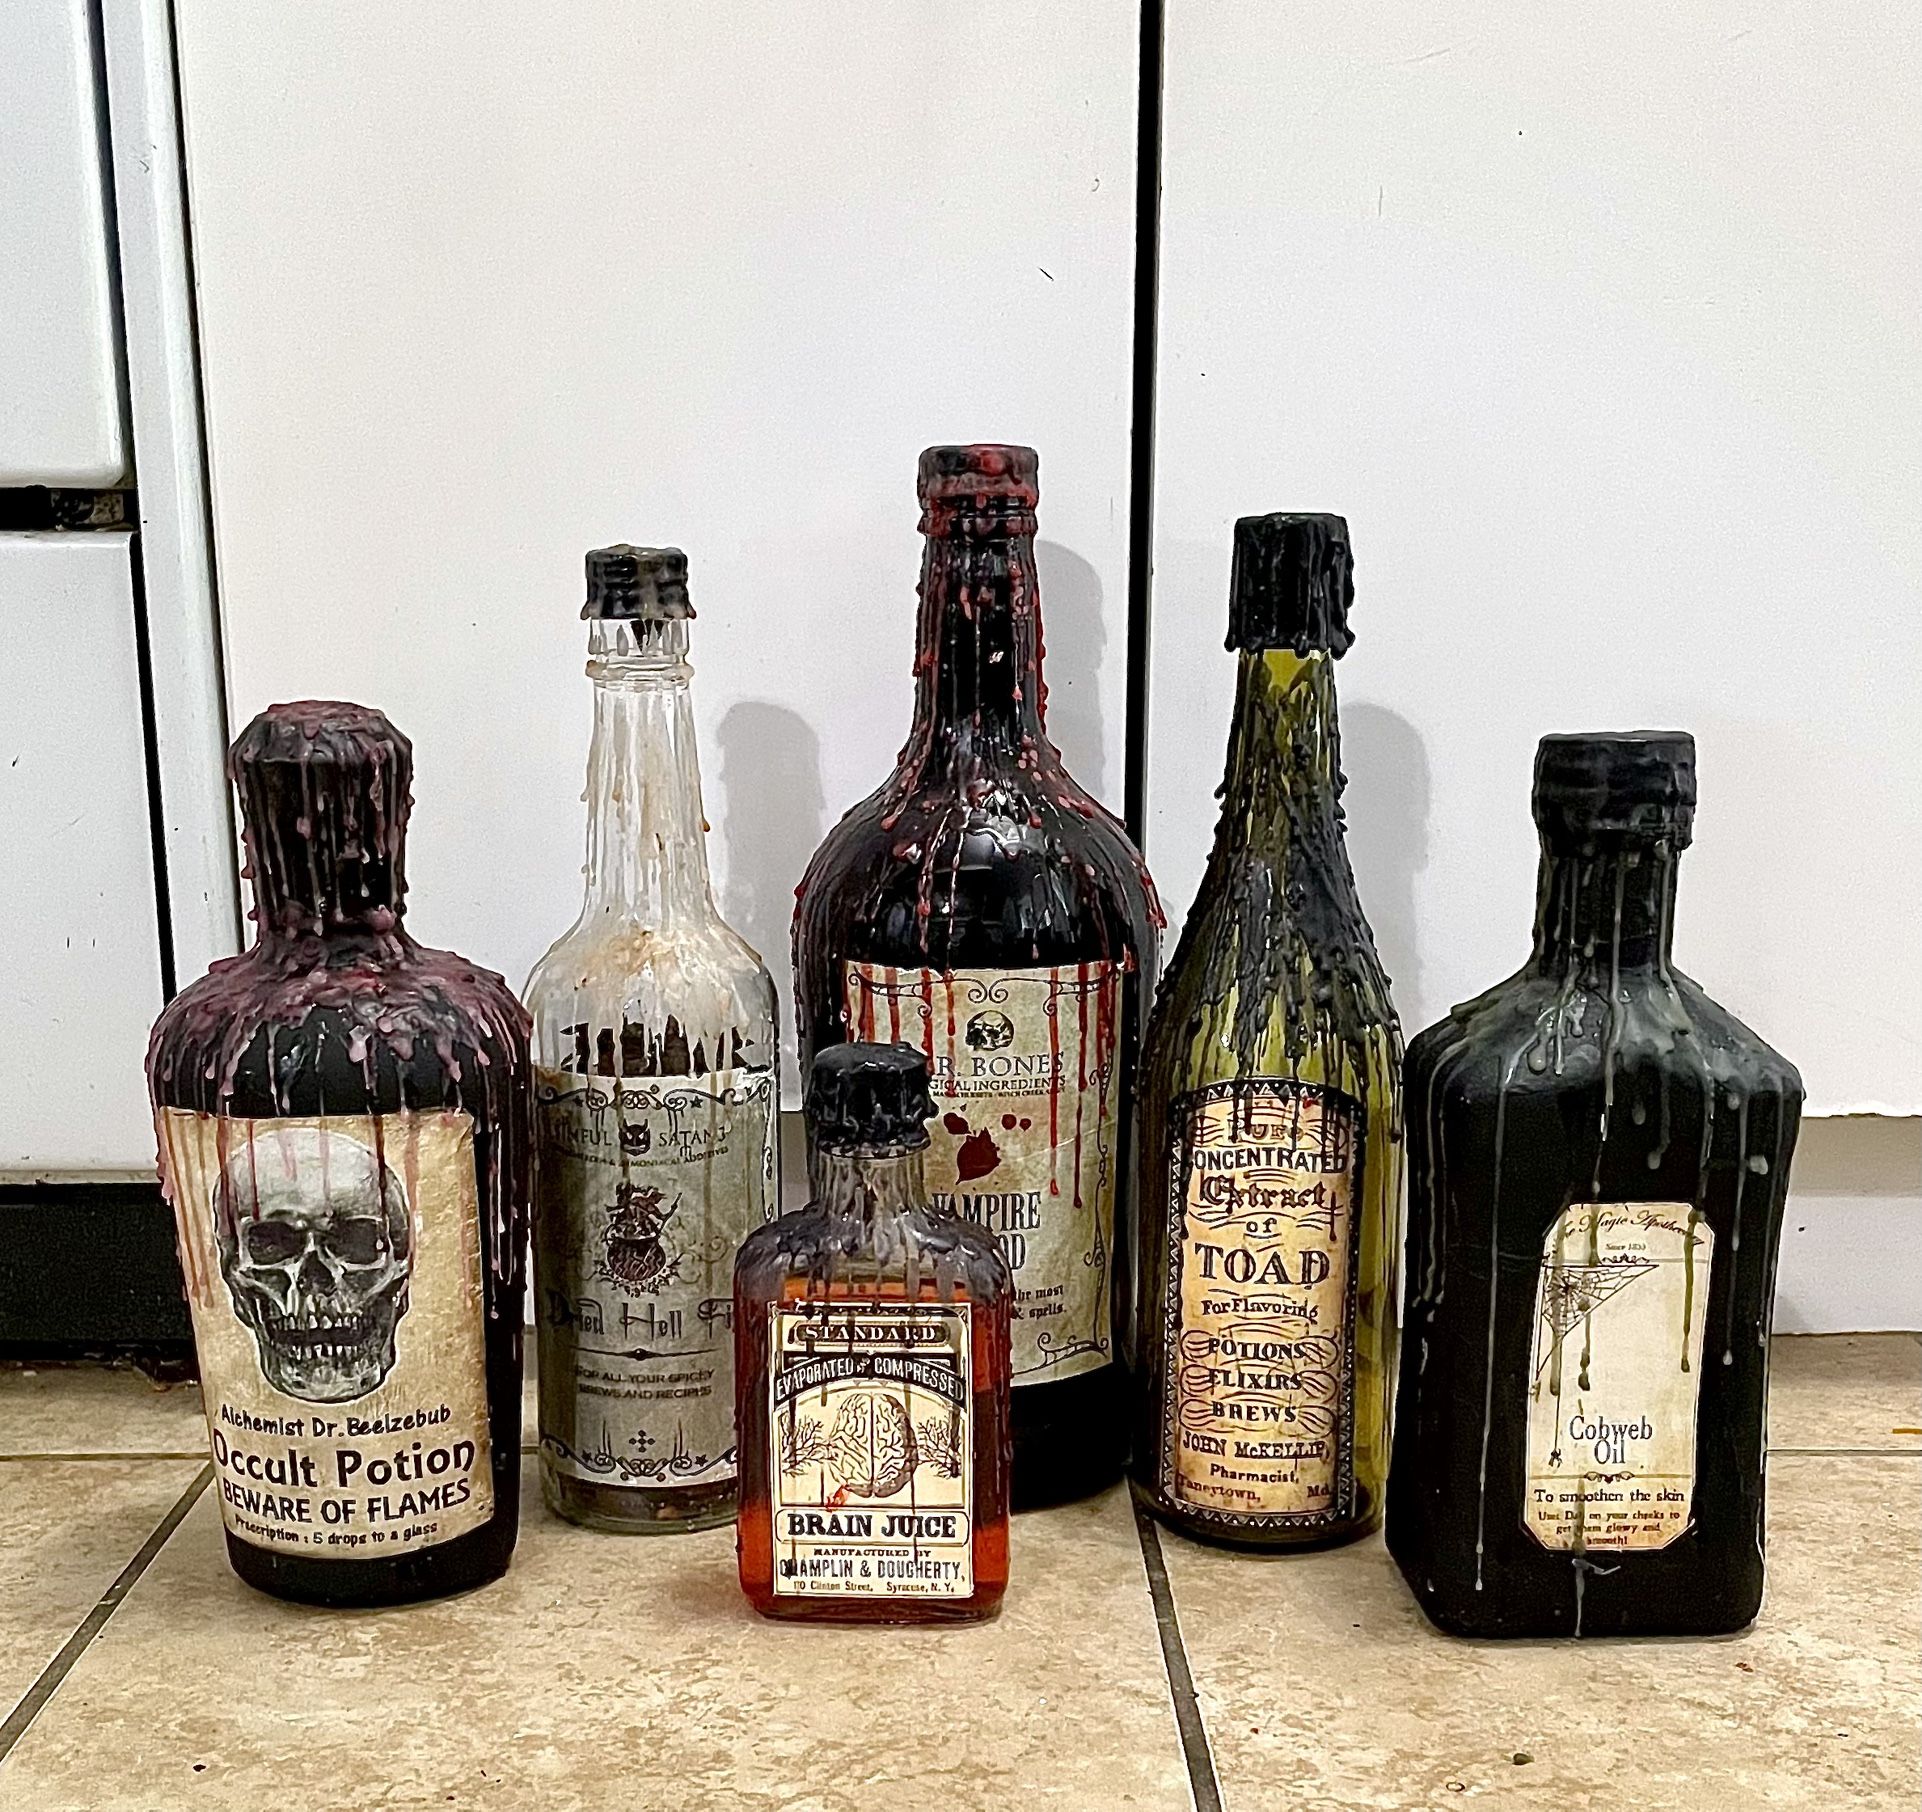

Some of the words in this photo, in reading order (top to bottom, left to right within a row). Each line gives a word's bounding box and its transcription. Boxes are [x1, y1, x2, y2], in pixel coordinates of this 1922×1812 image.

[971, 1052, 1065, 1077] BONES
[929, 1079, 970, 1091] GICAL
[1194, 1147, 1349, 1174] ONCENTRATED
[1246, 1218, 1276, 1233] of
[1195, 1242, 1330, 1286] TOAD
[1035, 1284, 1064, 1299] most
[1201, 1299, 1231, 1316] For
[1232, 1297, 1319, 1321] Flavoring
[619, 1303, 682, 1341] Hell
[805, 1325, 936, 1342] STANDARD
[1208, 1337, 1308, 1360] POTIONS
[602, 1370, 623, 1382] ALL
[628, 1372, 665, 1384] YOUR
[776, 1359, 854, 1400] EVAPORATED
[874, 1358, 964, 1400] COMPRESSED
[1208, 1368, 1304, 1391] ELIXIRS
[626, 1387, 653, 1400] AND
[221, 1403, 304, 1437] Alchemist
[1211, 1400, 1298, 1423] BREWS
[1569, 1415, 1653, 1441] Cobweb
[1183, 1430, 1228, 1457] JOHN
[1594, 1438, 1626, 1464] Oil
[214, 1428, 318, 1489] Occult
[336, 1440, 475, 1489] Potion
[223, 1477, 313, 1523] BEWARE
[320, 1500, 357, 1524] OF
[367, 1478, 471, 1523] FLAMES
[1534, 1489, 1554, 1503] To
[1559, 1488, 1624, 1502] smoothen
[1630, 1488, 1651, 1503] the
[1656, 1488, 1685, 1502] skin
[787, 1513, 873, 1537] BRAIN
[881, 1515, 957, 1538] JUICE
[1556, 1525, 1571, 1535] get
[1606, 1522, 1638, 1535] glowy
[1589, 1512, 1601, 1520] on
[1606, 1512, 1628, 1523] your
[1670, 1511, 1680, 1520] to
[313, 1532, 324, 1545] 5
[328, 1532, 367, 1548] drops
[372, 1529, 386, 1542] to
[391, 1531, 399, 1541] a
[404, 1521, 438, 1542] glass
[814, 1548, 910, 1557] MANUFACTURED
[859, 1559, 871, 1577] &
